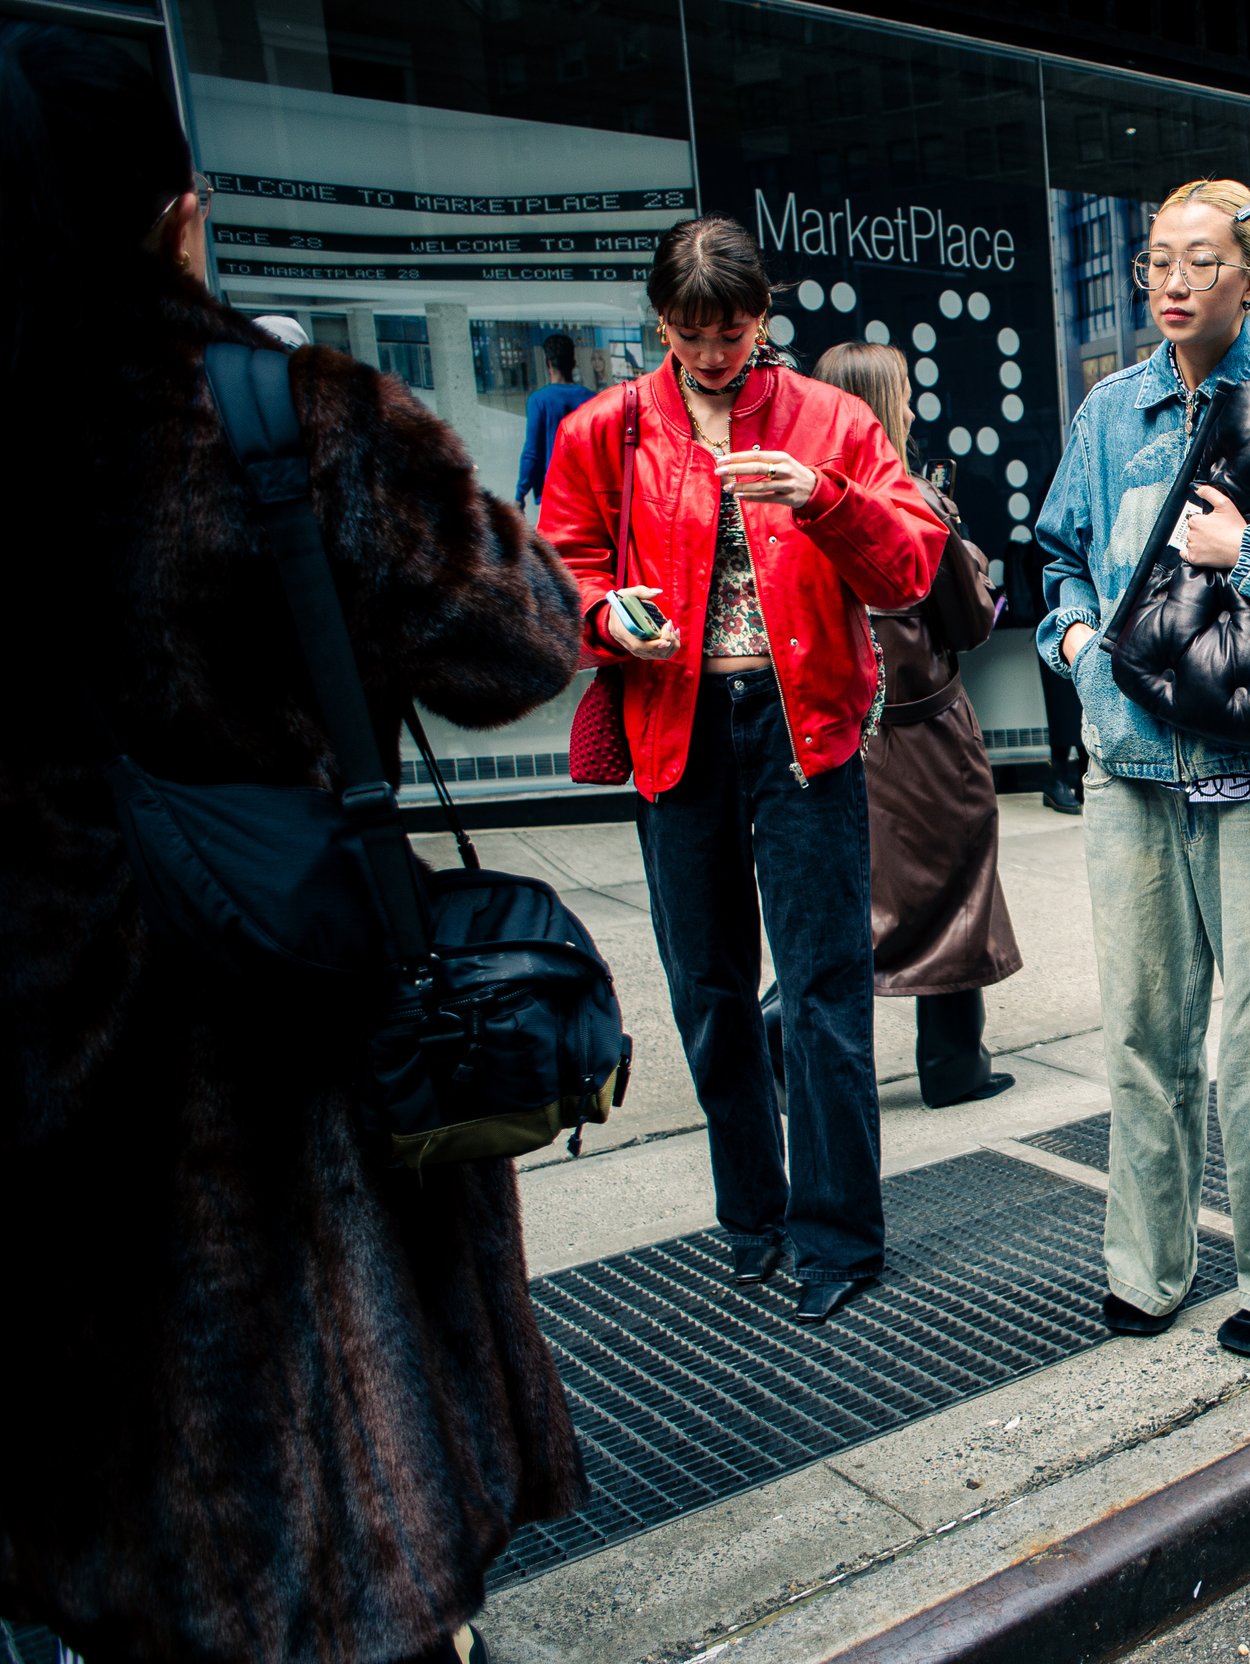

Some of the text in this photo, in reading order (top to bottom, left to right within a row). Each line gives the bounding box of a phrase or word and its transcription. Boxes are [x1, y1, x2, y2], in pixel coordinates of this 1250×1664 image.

[358, 188, 395, 206] TO
[414, 193, 621, 213] MARKETPLACE
[643, 191, 685, 208] 28
[755, 188, 1015, 271] MarketPlace
[289, 235, 323, 249] 28
[410, 238, 521, 253] WELCOME
[540, 238, 575, 251] TO
[226, 263, 251, 274] TO
[264, 265, 387, 280] MARKETPLACE
[397, 268, 420, 280] 28
[482, 268, 574, 280] WELCOME
[589, 268, 617, 280] TO
